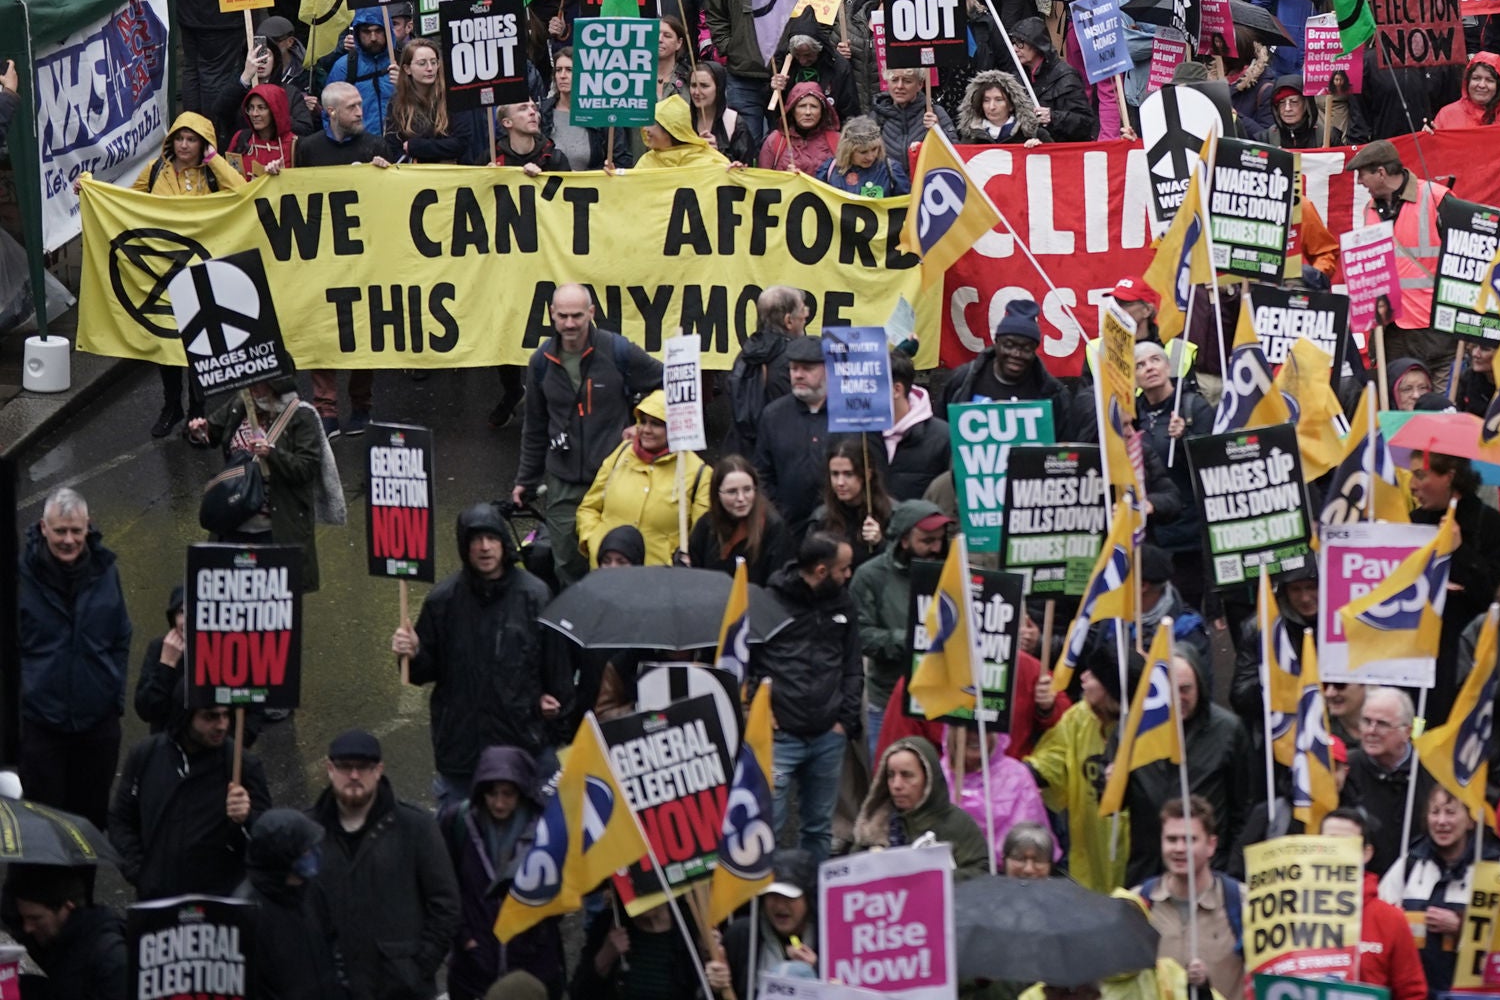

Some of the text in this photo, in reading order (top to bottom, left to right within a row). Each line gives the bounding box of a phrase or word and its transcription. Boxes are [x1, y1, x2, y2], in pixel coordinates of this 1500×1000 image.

[581, 23, 652, 49] CUT
[1381, 28, 1455, 65] NOW
[578, 47, 653, 73] WAR
[37, 39, 111, 157] NHS
[578, 72, 650, 97] NOT
[578, 97, 649, 110] WELFARE
[254, 189, 365, 262] WE
[409, 176, 599, 258] CAN'T
[326, 282, 460, 353] THIS
[196, 567, 293, 603] GENERAL
[194, 598, 293, 633] ELECTION
[194, 631, 293, 687] NOW
[843, 889, 910, 925] Pay
[851, 918, 928, 953] Rise
[834, 946, 933, 986] Now!
